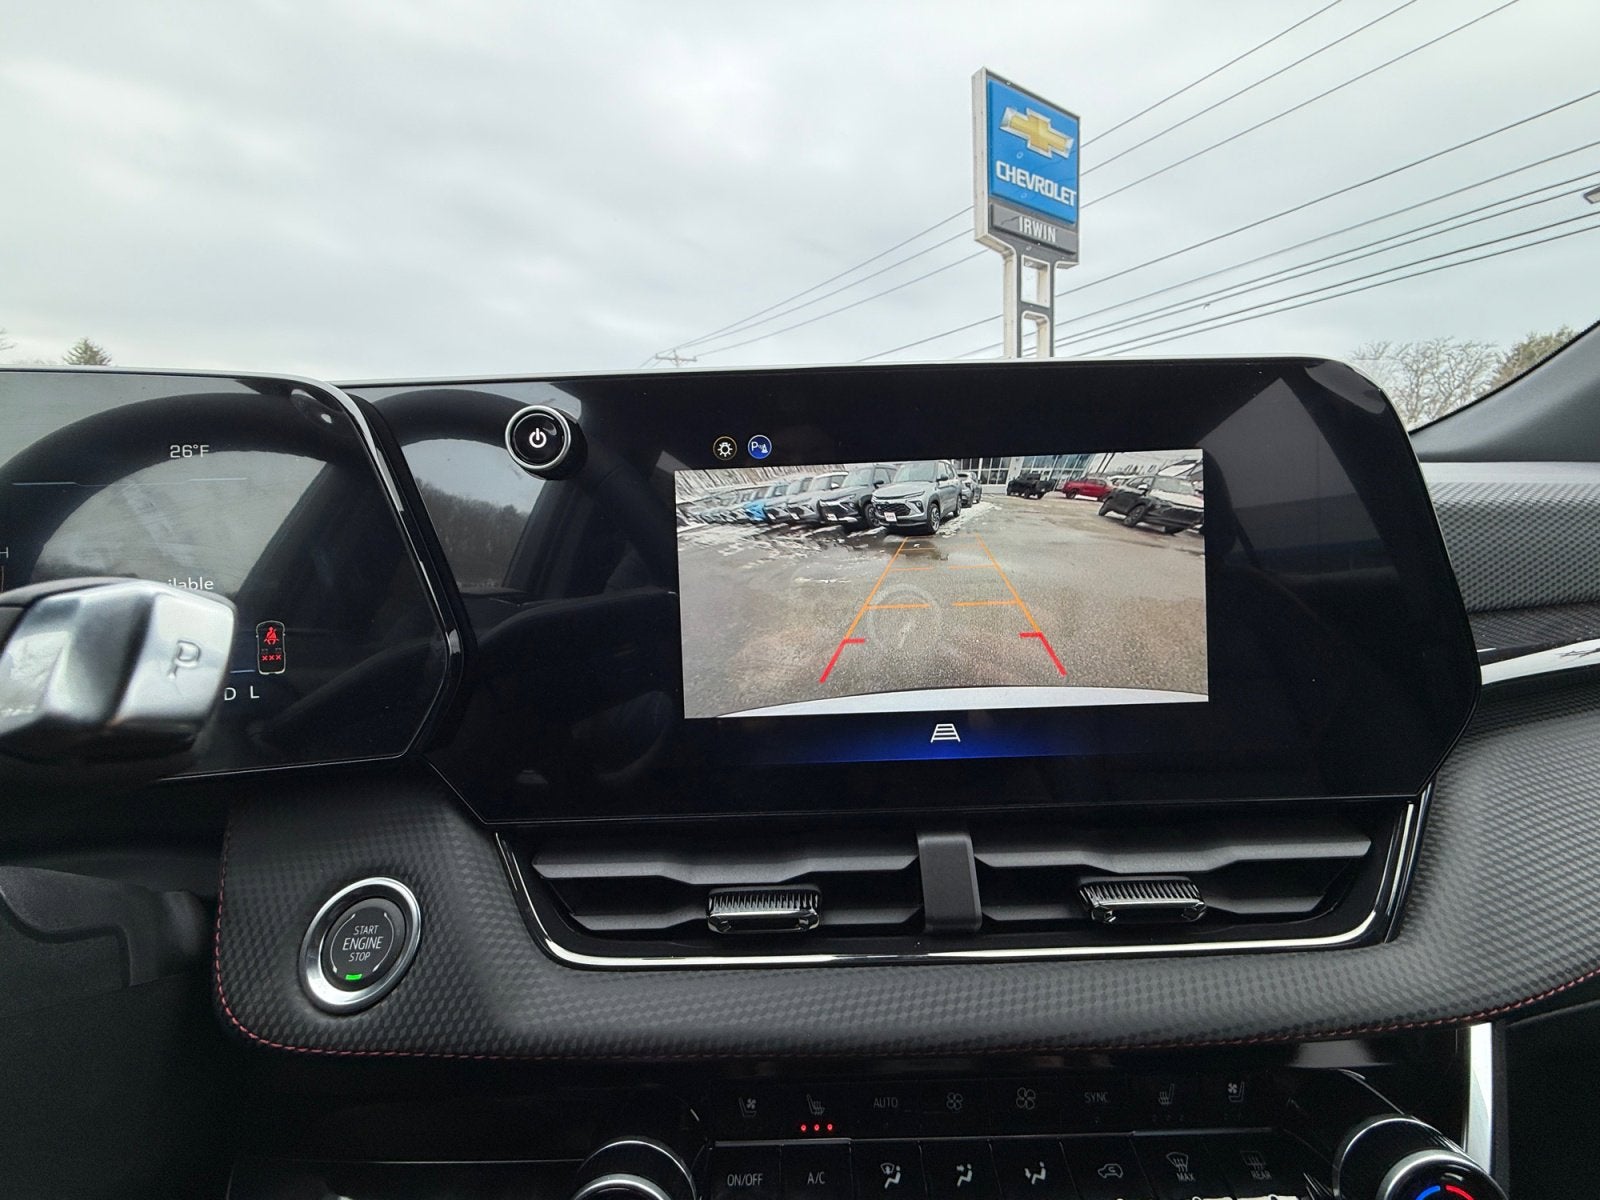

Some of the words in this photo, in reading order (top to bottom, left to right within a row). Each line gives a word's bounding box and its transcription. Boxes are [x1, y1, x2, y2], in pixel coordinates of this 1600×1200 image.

[996, 160, 1077, 207] CHEVROLET
[1019, 215, 1056, 243] IRWIN
[169, 444, 210, 458] 26°F
[168, 576, 214, 591] ilable
[223, 687, 237, 700] D
[249, 685, 260, 699] L
[353, 925, 379, 936] START
[342, 936, 384, 951] ENGINE
[348, 952, 371, 962] STOP
[873, 1096, 898, 1109] AUTO
[1084, 1091, 1109, 1103] SYNC
[726, 1172, 764, 1187] ON/OFF
[807, 1171, 826, 1185] A/C
[1176, 1172, 1196, 1182] MAX
